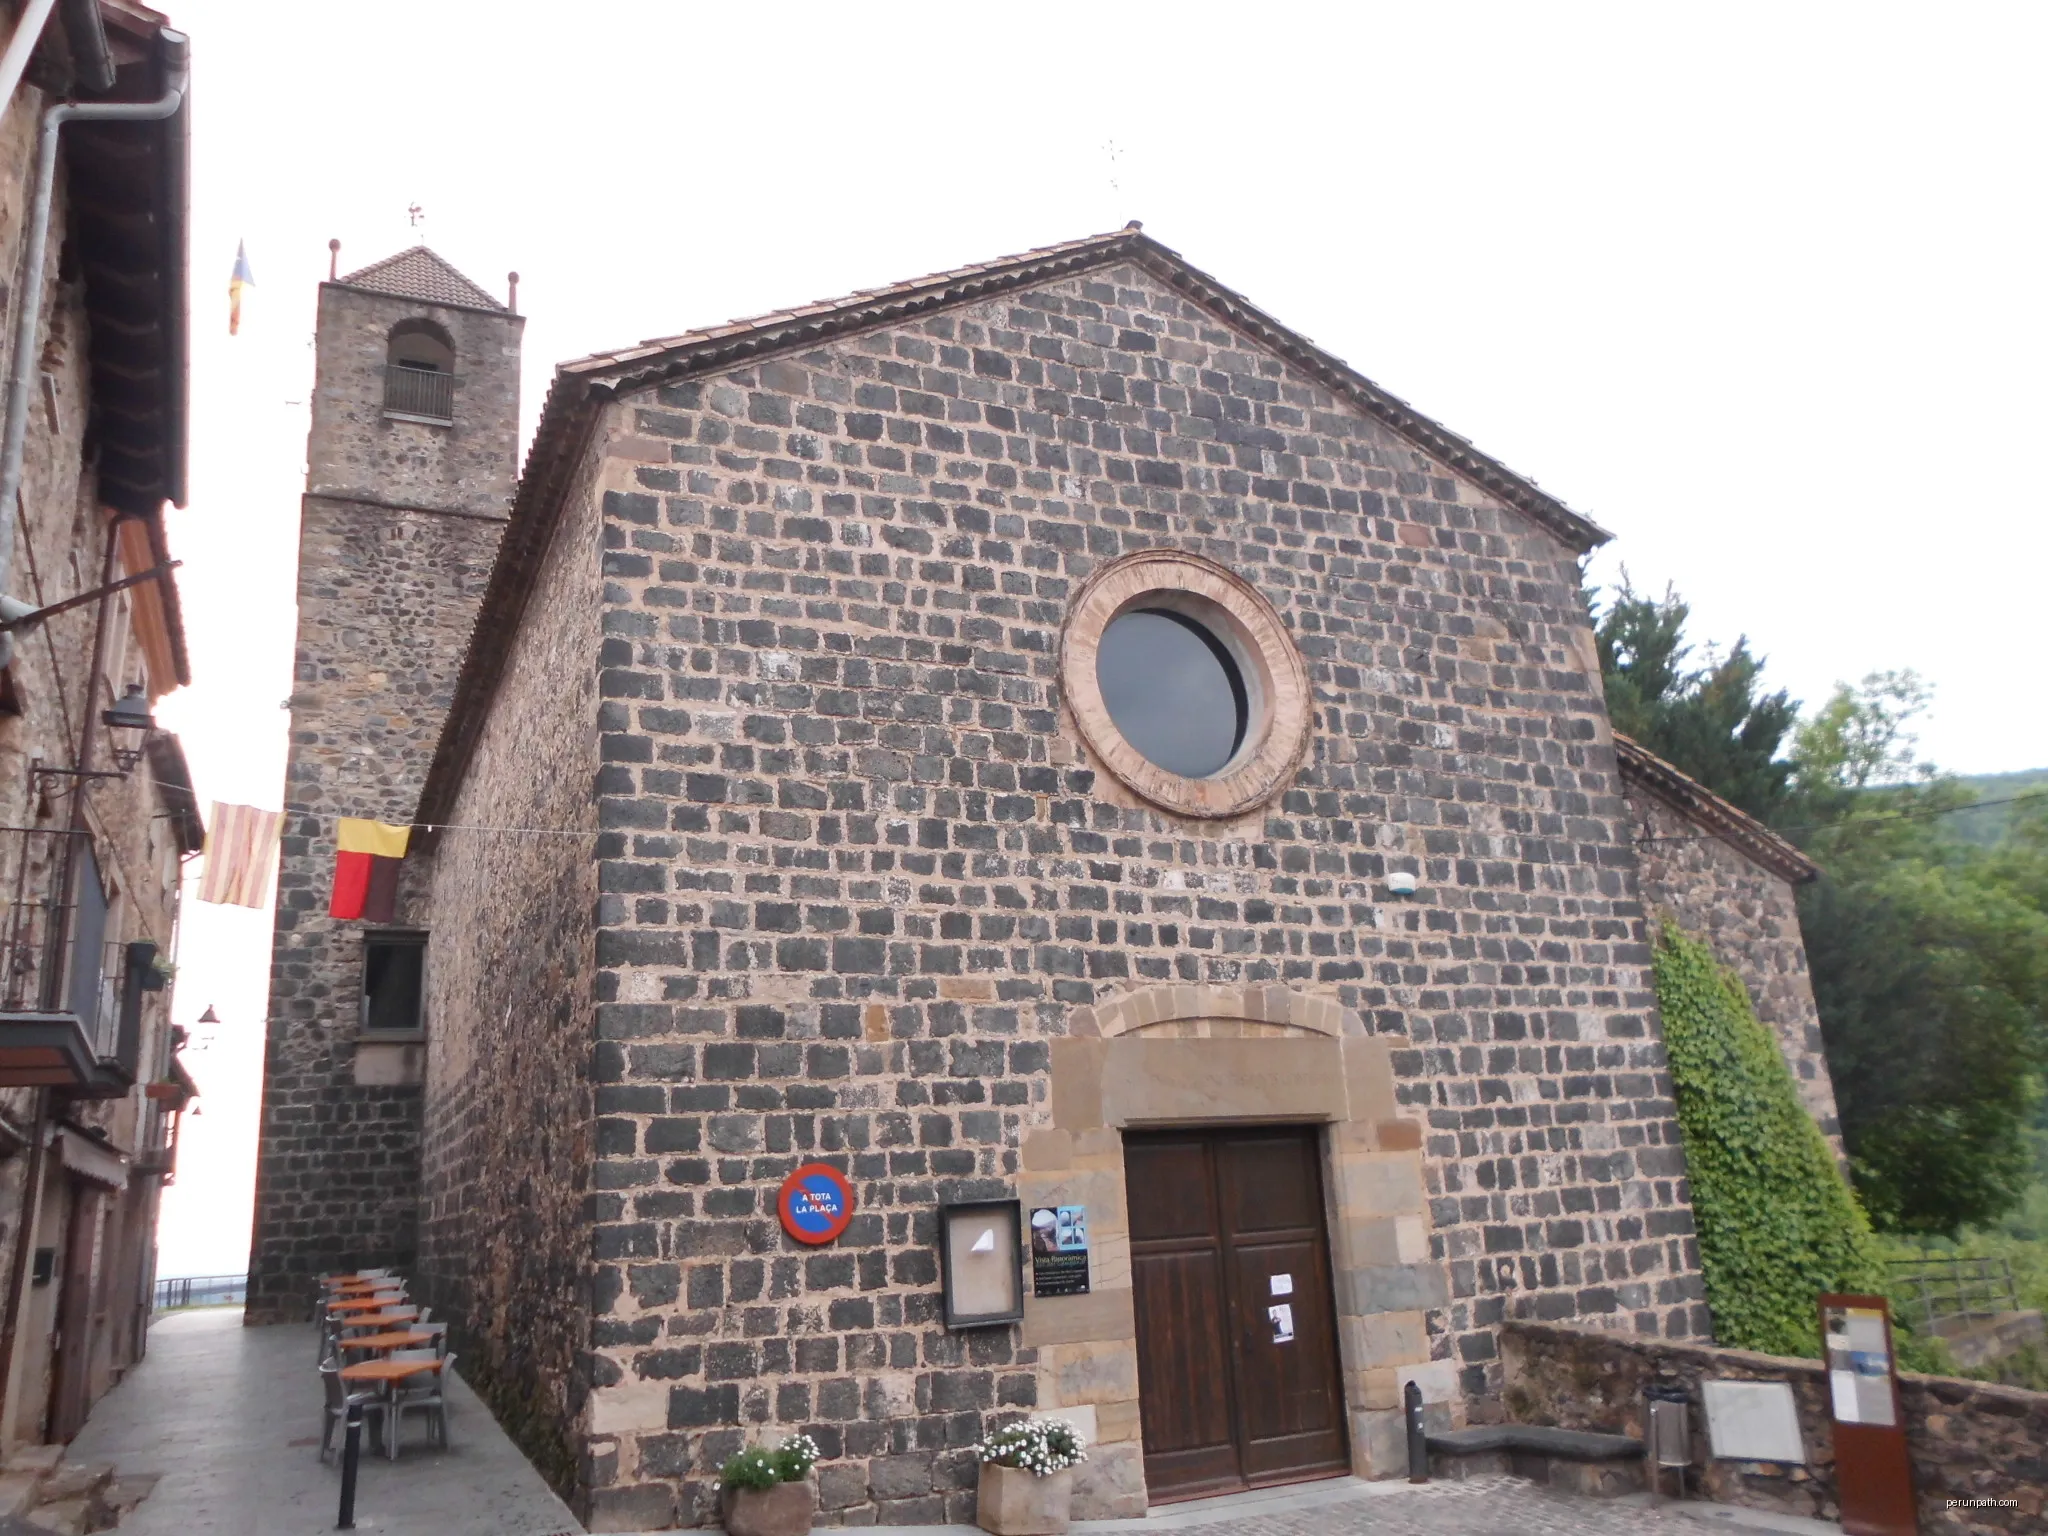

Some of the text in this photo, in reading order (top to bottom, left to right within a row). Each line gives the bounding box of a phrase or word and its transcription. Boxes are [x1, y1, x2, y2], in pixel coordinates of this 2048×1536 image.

[802, 1192, 831, 1201] A TOTA
[796, 1203, 838, 1213] LA PLAÇA
